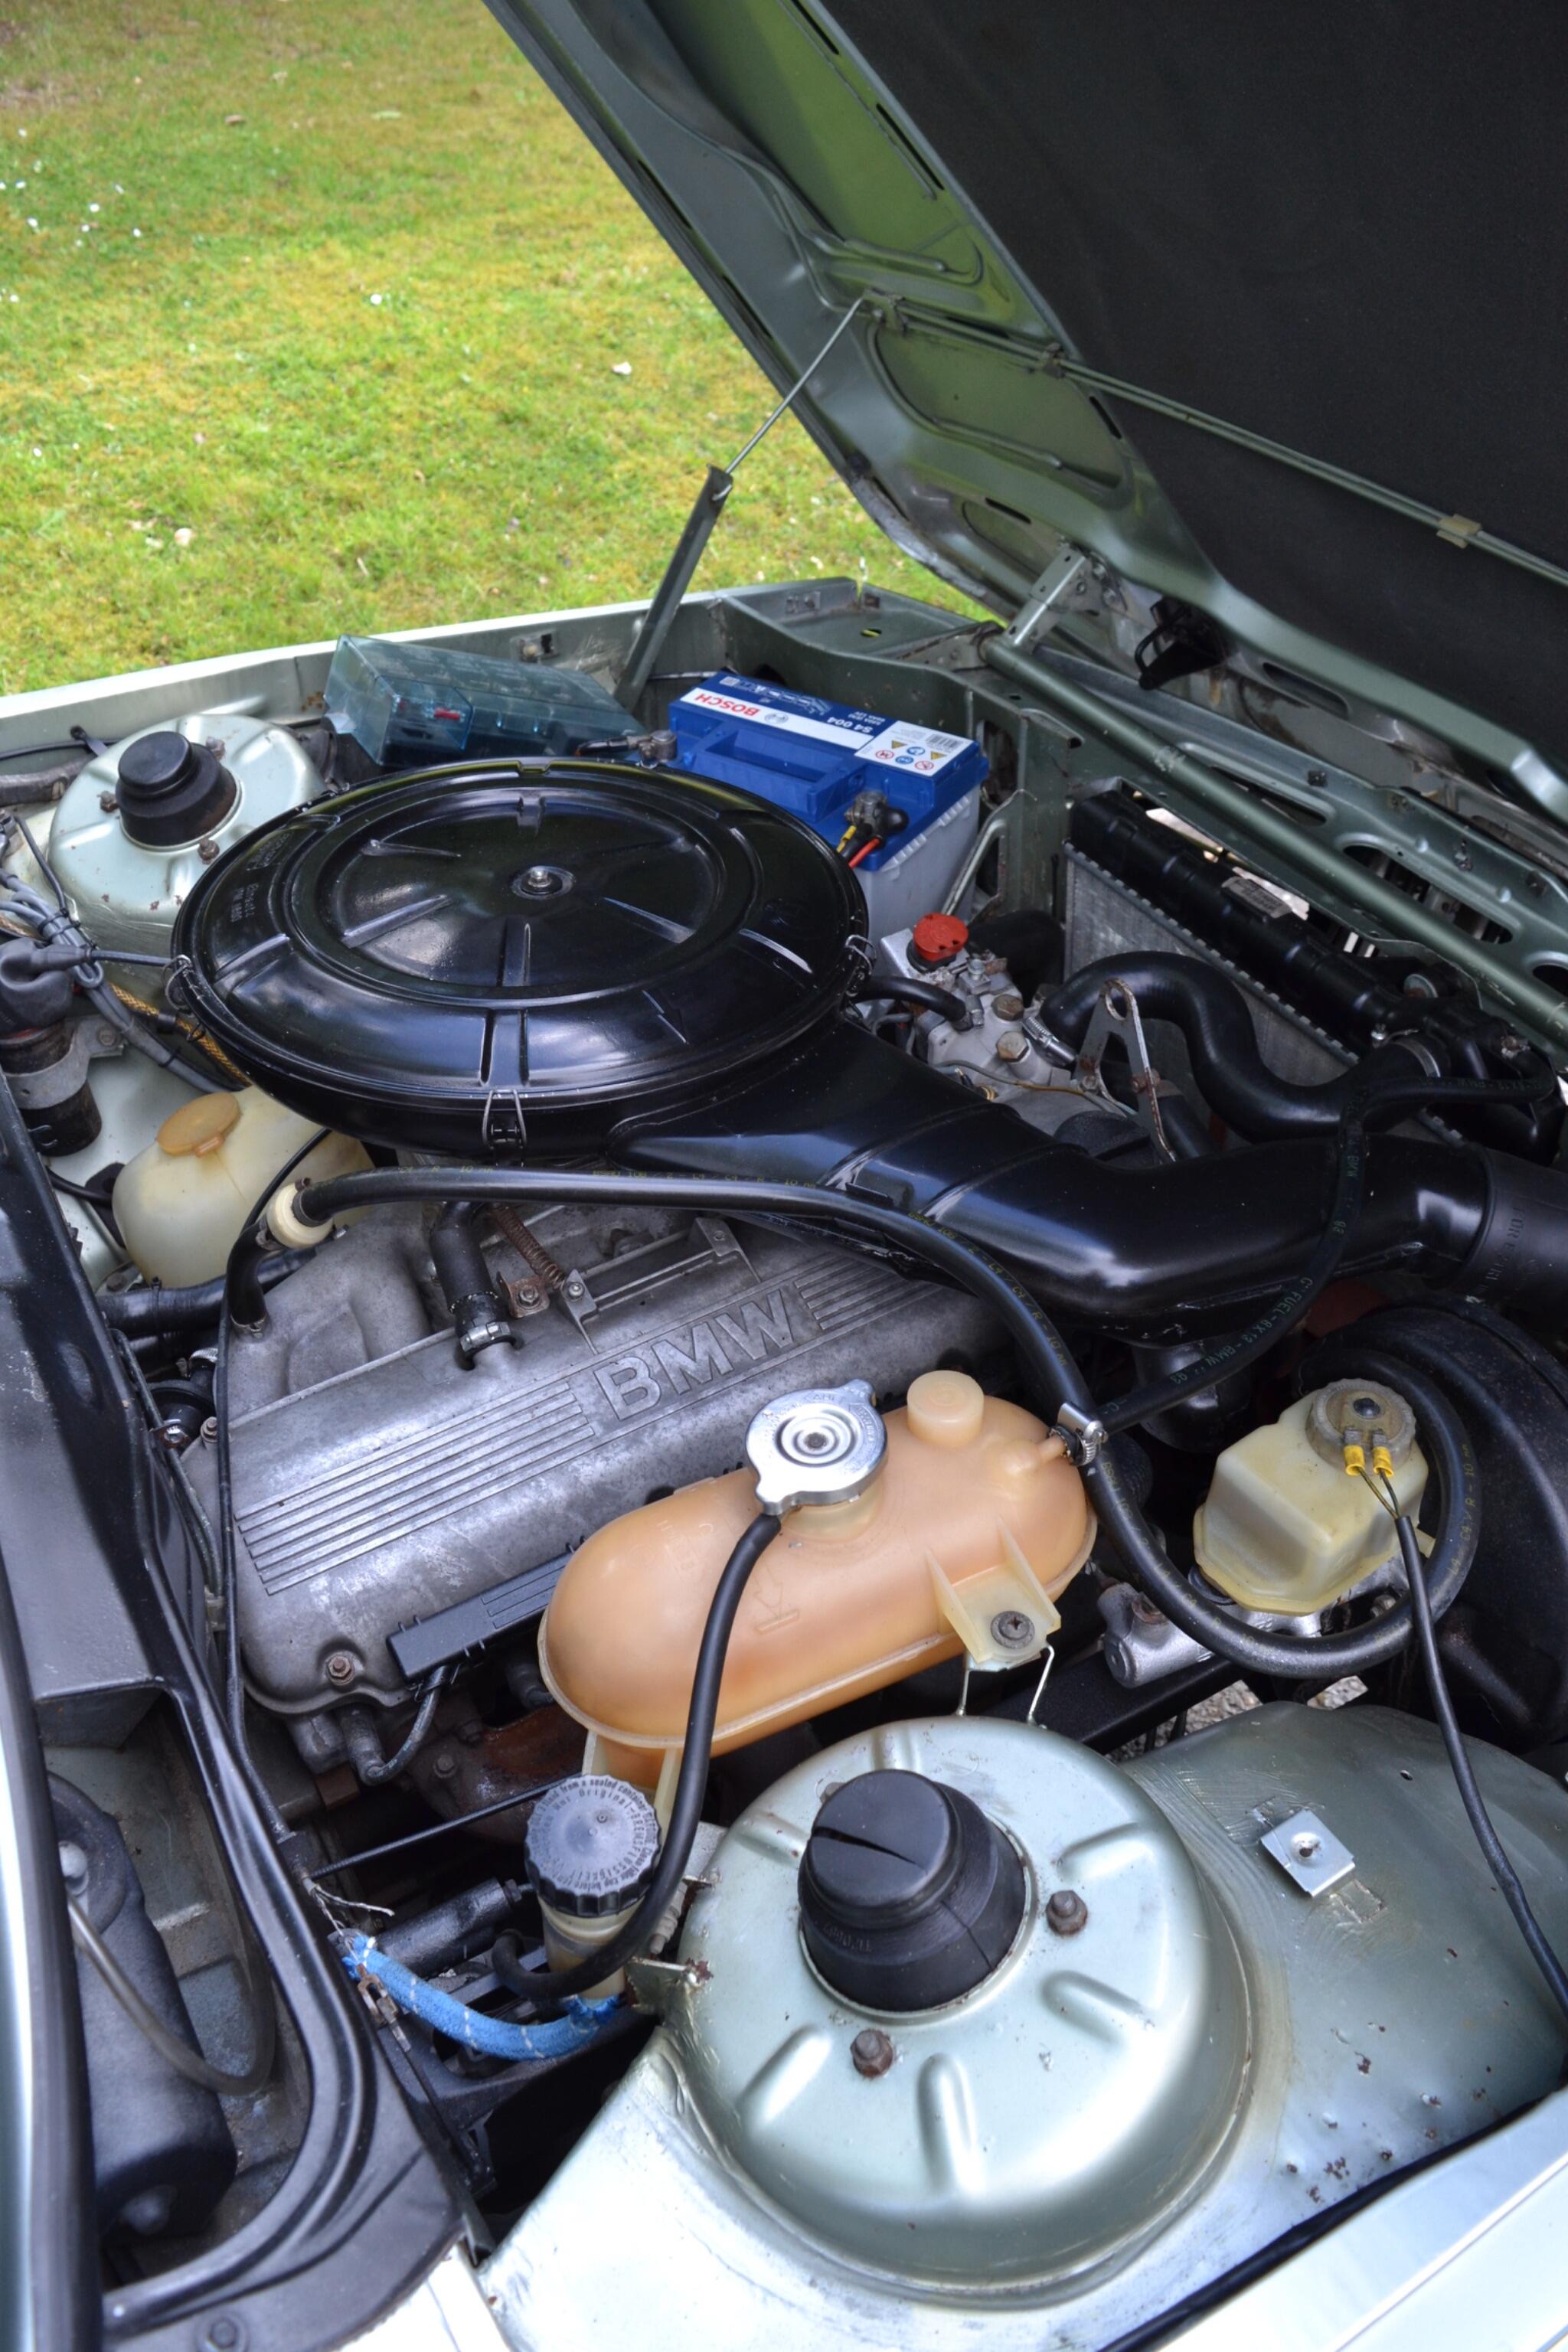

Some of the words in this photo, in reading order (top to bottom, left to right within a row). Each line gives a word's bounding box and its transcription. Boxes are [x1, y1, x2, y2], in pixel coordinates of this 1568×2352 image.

[694, 693, 761, 717] BOSCH
[827, 716, 854, 728] 004
[854, 724, 874, 733] S4
[1047, 1336, 1061, 1350] 10
[593, 1289, 795, 1423] BMW
[1464, 1462, 1475, 1478] 10
[560, 1781, 580, 1794] from
[590, 1778, 618, 1788] sealed
